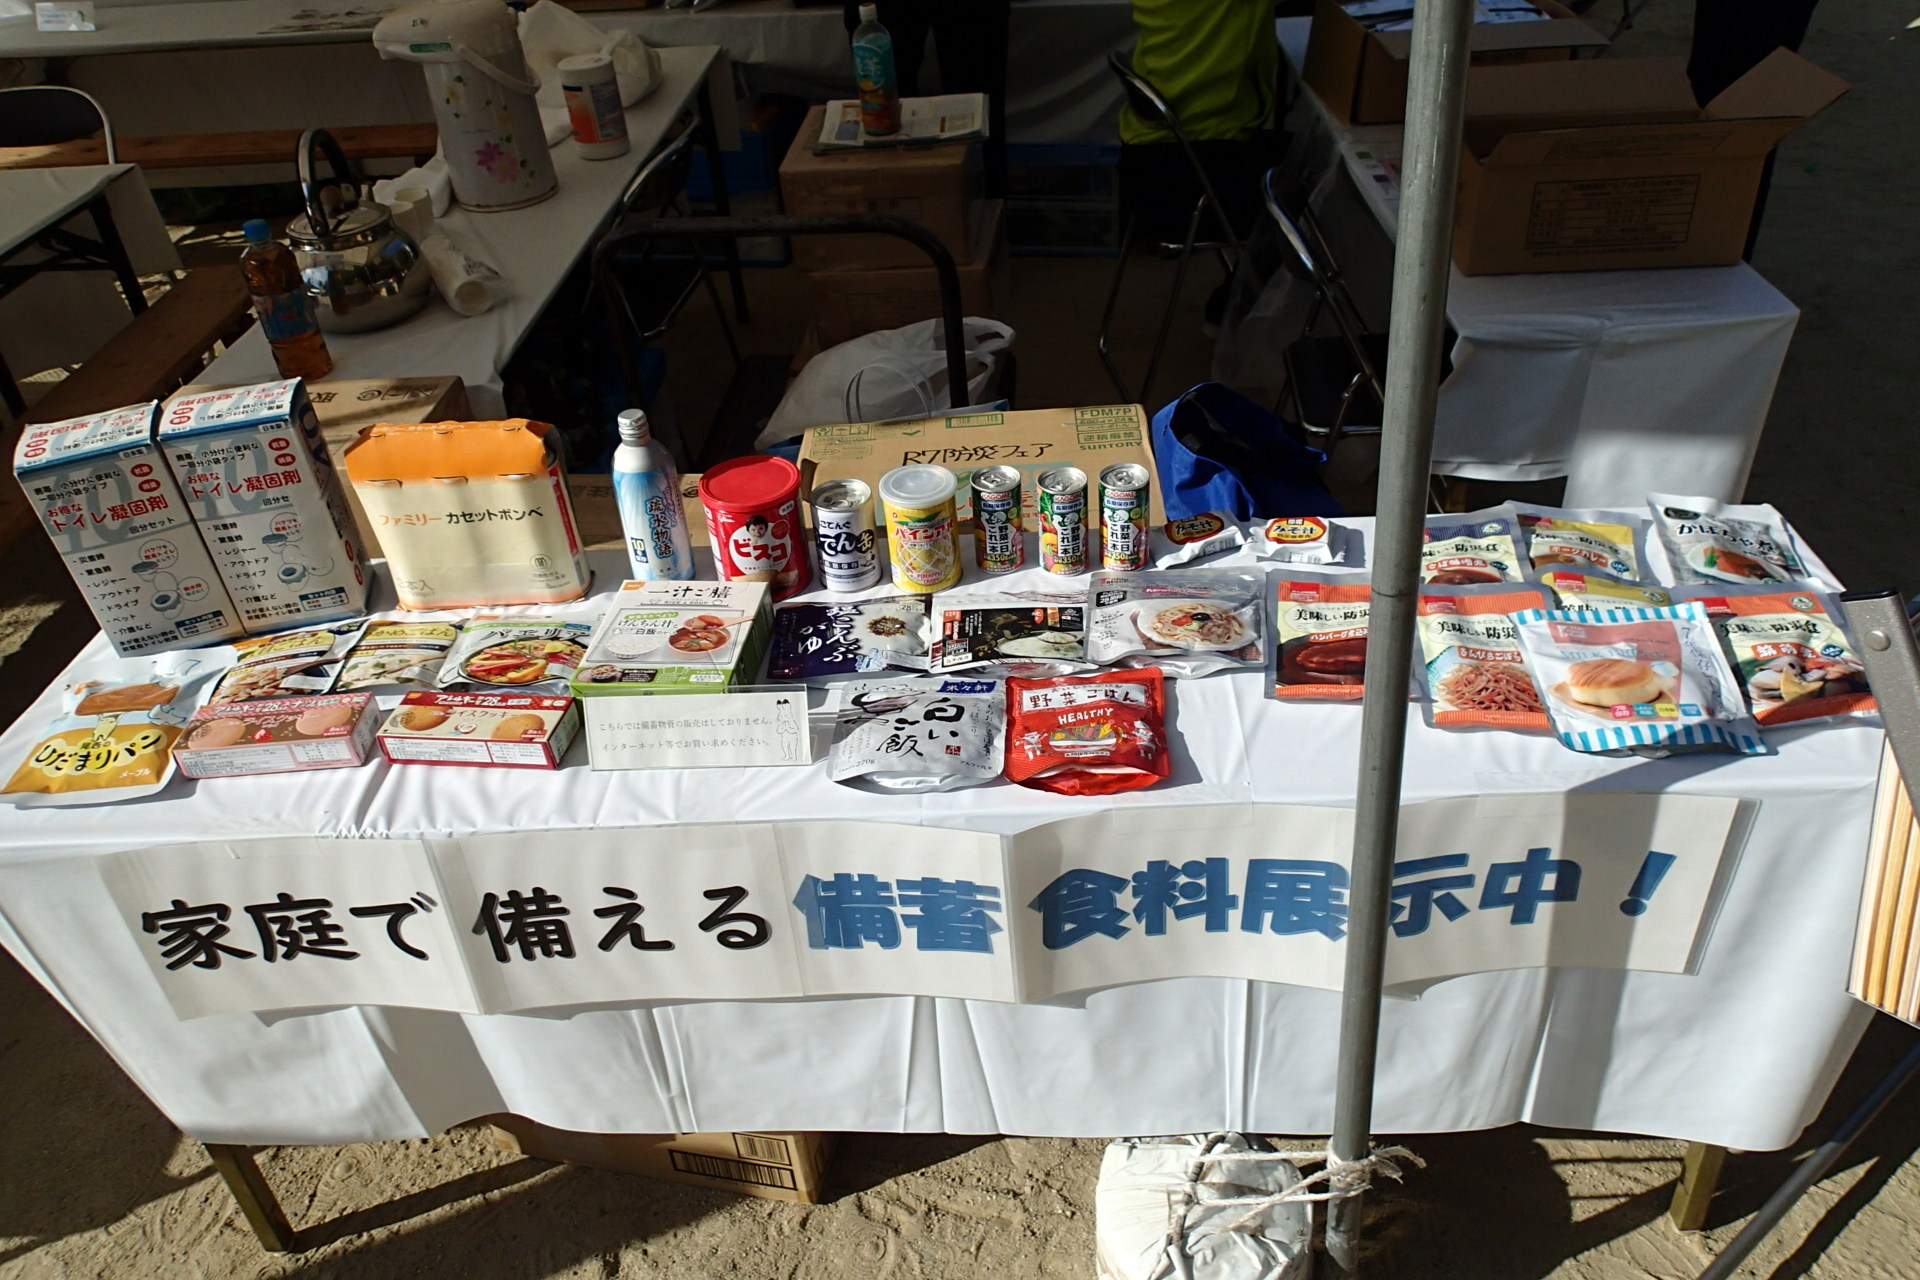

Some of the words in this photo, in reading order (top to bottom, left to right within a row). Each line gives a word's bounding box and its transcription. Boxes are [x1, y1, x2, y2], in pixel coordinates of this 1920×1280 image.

[1080, 408, 1132, 418] FDM7P
[1079, 441, 1142, 451] SUNTORY
[191, 468, 302, 499] トイレ凝固剤
[981, 491, 1012, 501] KAGOME
[1054, 493, 1083, 503] KAGOME
[1106, 490, 1136, 499] KAGOME
[52, 493, 169, 534] トイレ凝固剤
[379, 513, 443, 527] ファミリー
[446, 506, 544, 525] カセットボンベ
[819, 520, 852, 529] こてんぐ
[1273, 525, 1317, 535] みそ汁
[817, 529, 875, 556] でん缶
[988, 525, 999, 553] これ一本
[998, 525, 1010, 553] 野菜一日
[1060, 528, 1070, 556] これ一本
[1070, 525, 1081, 555] 野菜一日
[1110, 525, 1120, 551] これ一本
[1119, 524, 1131, 552] 野菜一日
[733, 538, 788, 562] ビスコ
[1550, 546, 1607, 564] ポークカレー
[647, 585, 732, 599] 一汁ご膳
[1294, 608, 1370, 622] 美味しい防災
[480, 627, 591, 642] パエリア
[1437, 620, 1518, 641] 美味しい防災
[1029, 688, 1139, 709] 野菜ごはん
[599, 716, 774, 732] こちらでは備蓄物資の販売はしておりません。
[923, 696, 965, 740] 白い
[1057, 707, 1115, 725] HEALTHY
[34, 733, 162, 772] ひだまりパン
[602, 737, 770, 752] インターネット等でお買い求めください。
